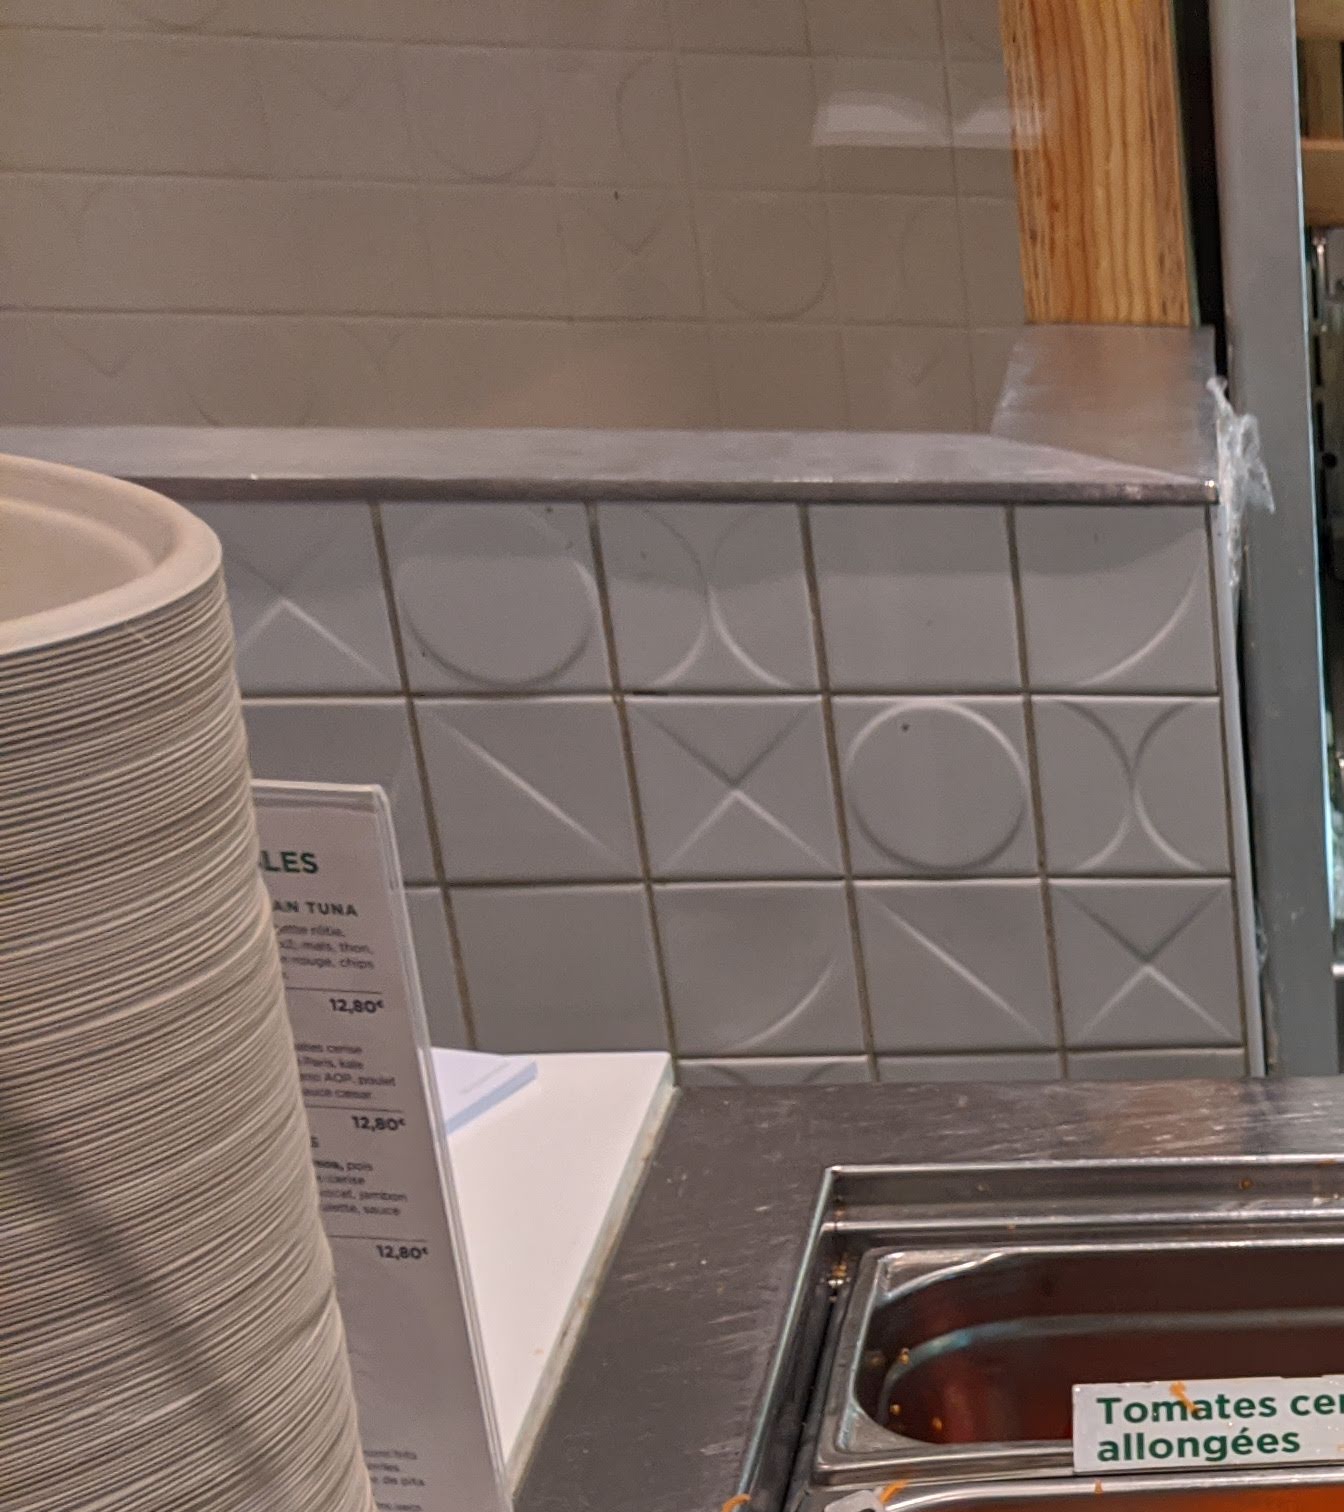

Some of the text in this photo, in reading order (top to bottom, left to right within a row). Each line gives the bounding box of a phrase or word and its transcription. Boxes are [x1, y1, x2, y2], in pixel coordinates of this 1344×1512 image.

[305, 901, 359, 917] TUNA
[1097, 1391, 1278, 1425] Tomates
[1097, 1427, 1301, 1463] allongées
